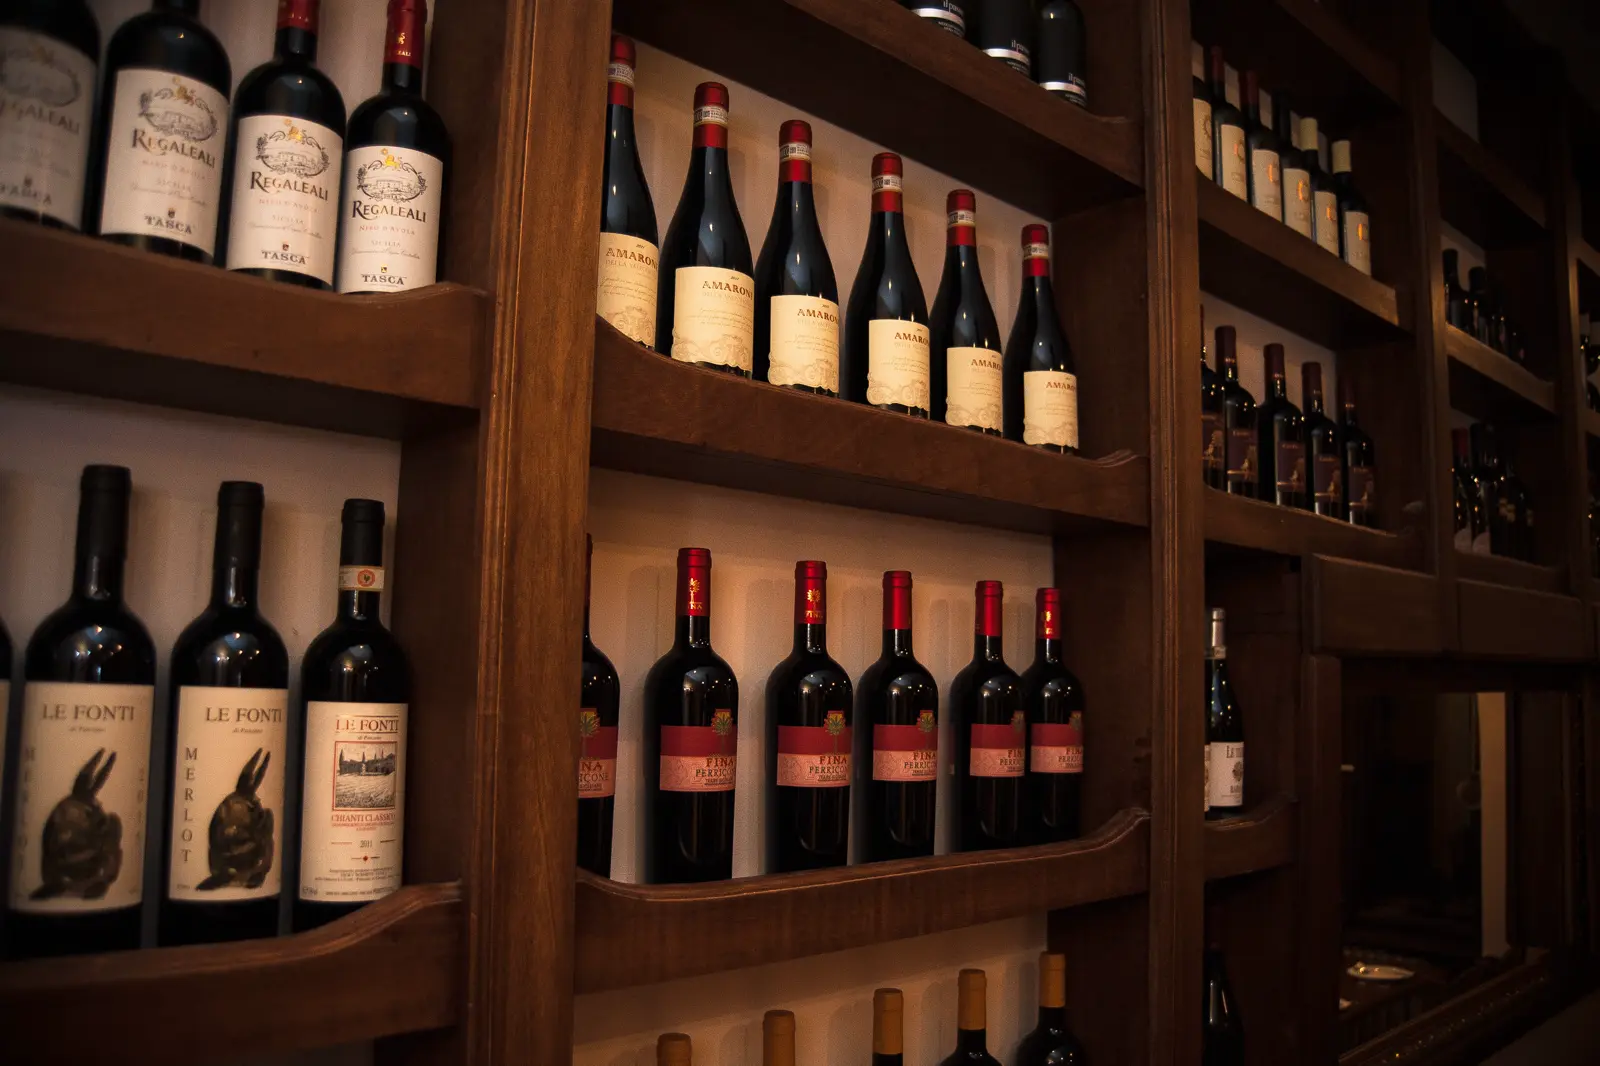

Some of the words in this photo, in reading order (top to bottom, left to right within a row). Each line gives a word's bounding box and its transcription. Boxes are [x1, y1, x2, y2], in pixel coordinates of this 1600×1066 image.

[131, 128, 215, 169] REGALEALI
[250, 171, 329, 201] REGALEALI
[352, 200, 427, 223] REGALEALI
[144, 215, 193, 235] TASCA
[261, 251, 307, 265] TASCA
[361, 274, 405, 286] TASCA
[42, 704, 68, 720] LE
[73, 704, 135, 721] FONTI
[205, 707, 230, 722] LE
[235, 707, 282, 723] FONTI
[336, 719, 357, 731] LE
[360, 719, 399, 731] FONTI
[706, 757, 734, 768] FINA
[819, 755, 847, 765] FINA
[182, 747, 198, 862] MERLOT
[331, 813, 364, 822] CHIANTI
[360, 840, 373, 848] 2011
